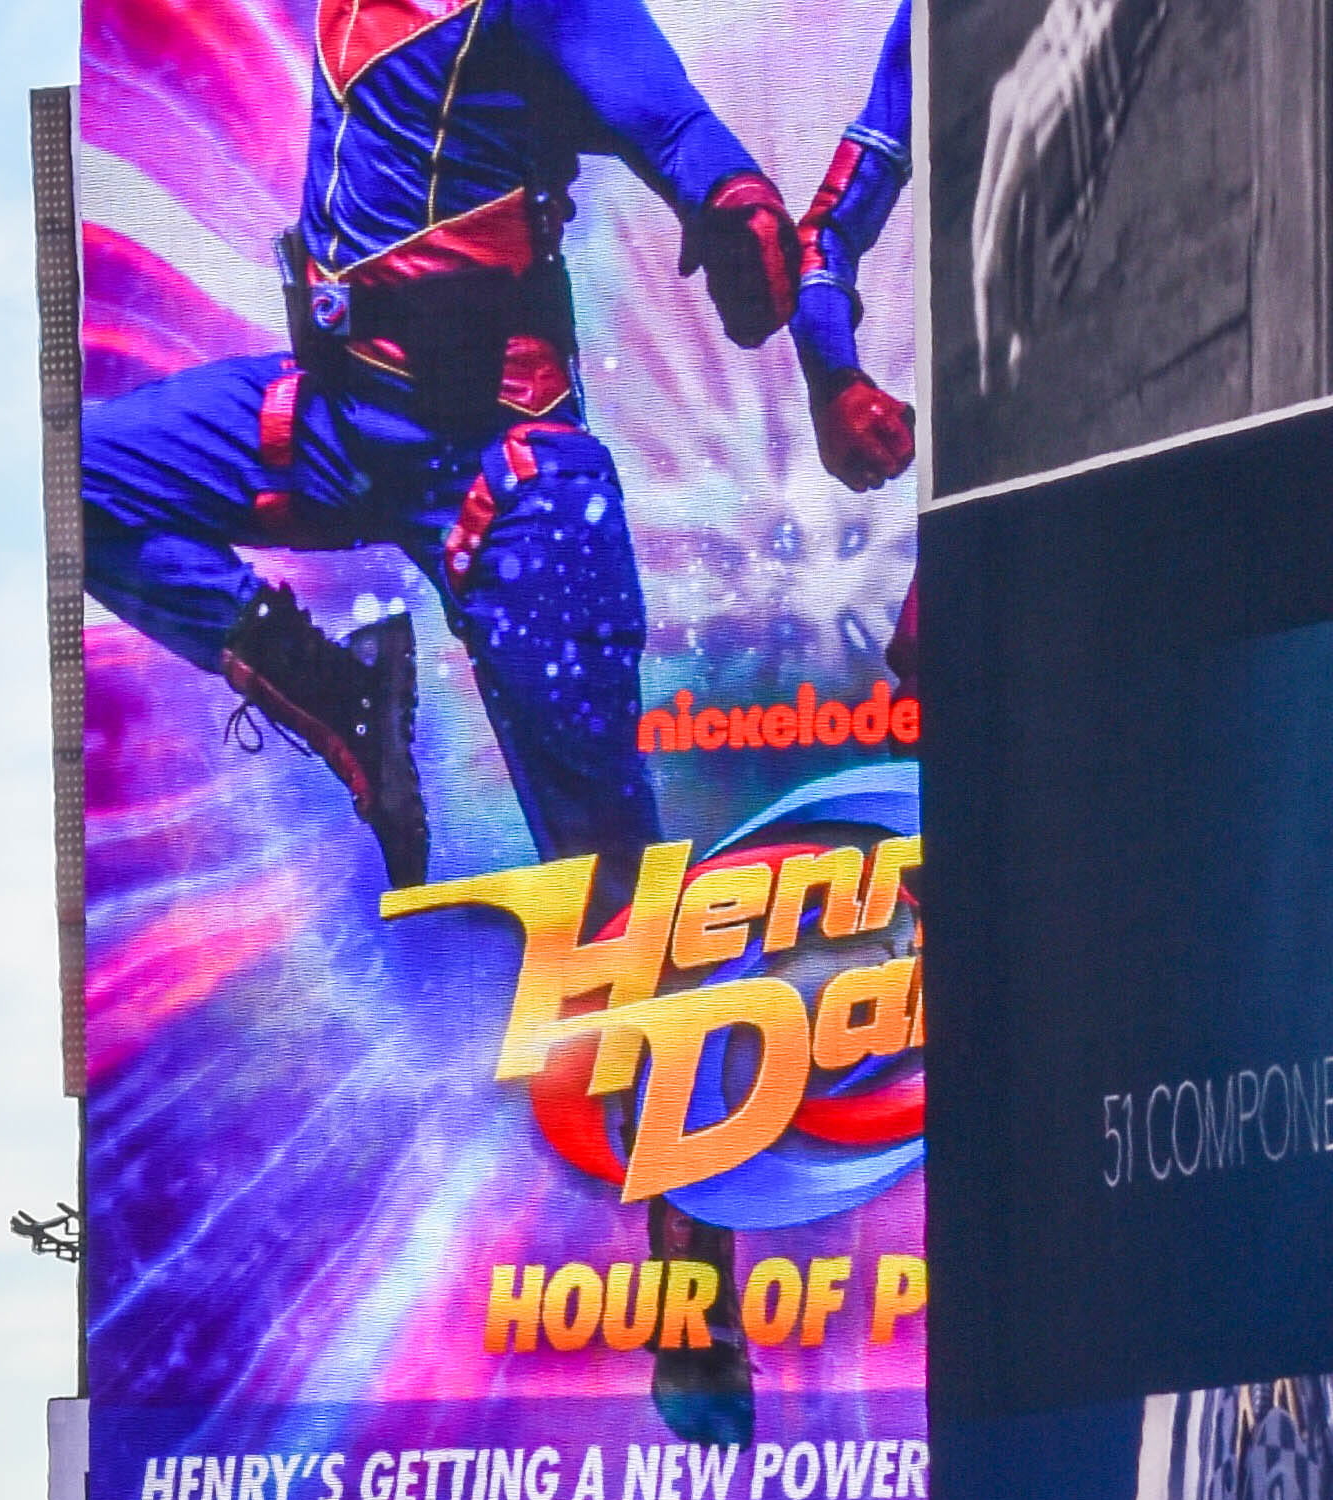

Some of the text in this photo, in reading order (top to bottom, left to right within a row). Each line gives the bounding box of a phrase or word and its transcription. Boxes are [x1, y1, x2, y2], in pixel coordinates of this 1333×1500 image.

[531, 955, 925, 1203] Da
[1103, 1093, 1132, 1187] 51
[482, 1255, 719, 1354] HOUR
[741, 1256, 849, 1348] OF
[748, 1438, 928, 1500] POWER
